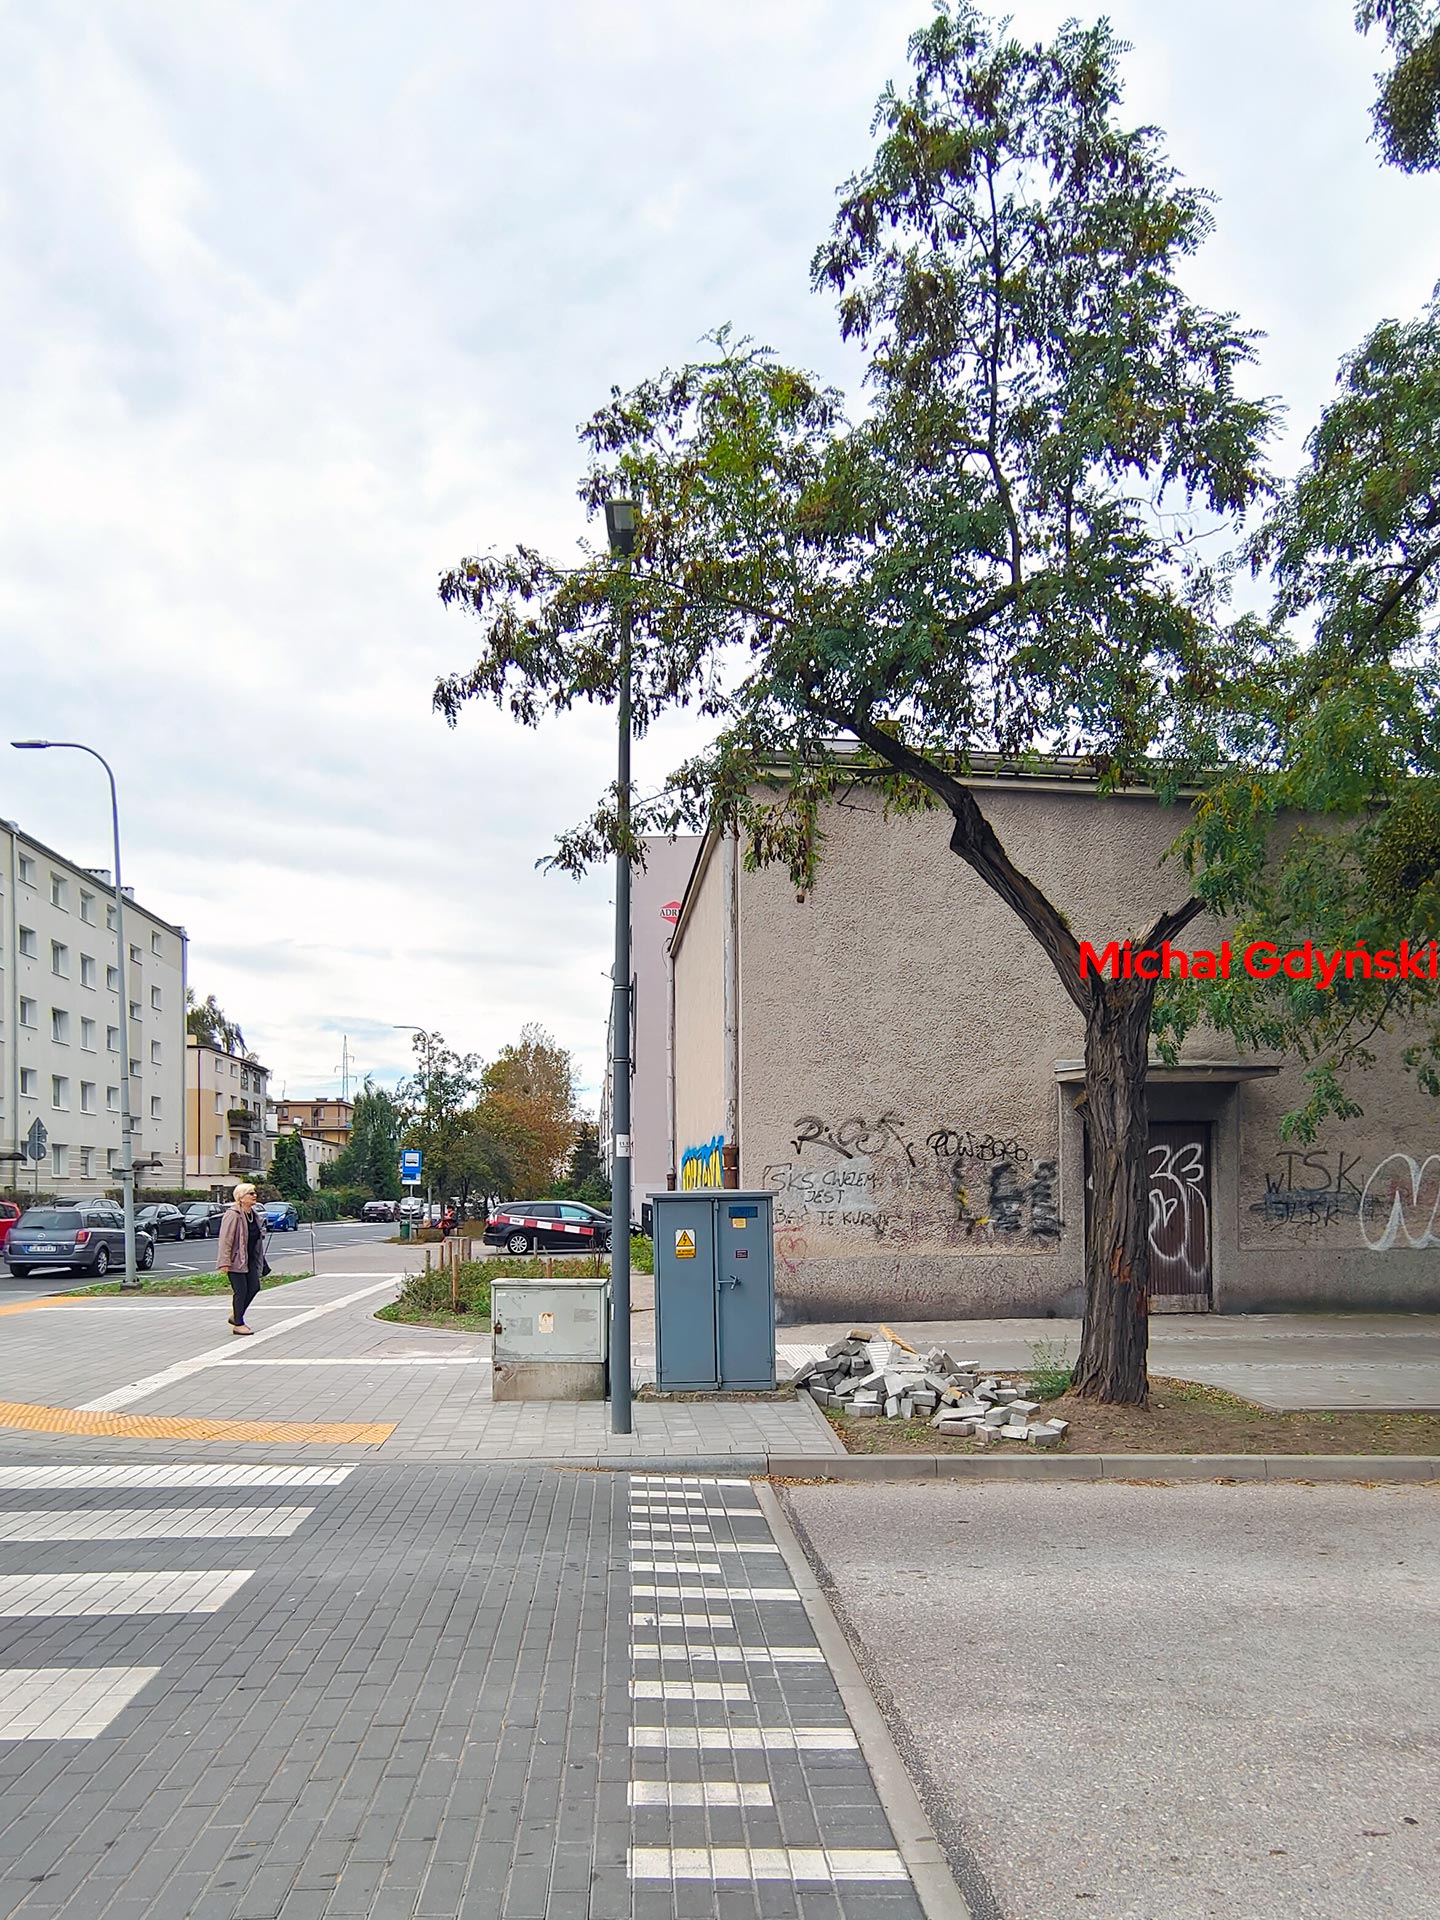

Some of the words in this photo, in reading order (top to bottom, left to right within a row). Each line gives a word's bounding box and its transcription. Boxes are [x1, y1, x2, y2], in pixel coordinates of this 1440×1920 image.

[660, 908, 681, 917] ADR
[771, 1172, 814, 1191] SKS
[805, 1190, 844, 1204] JEST
